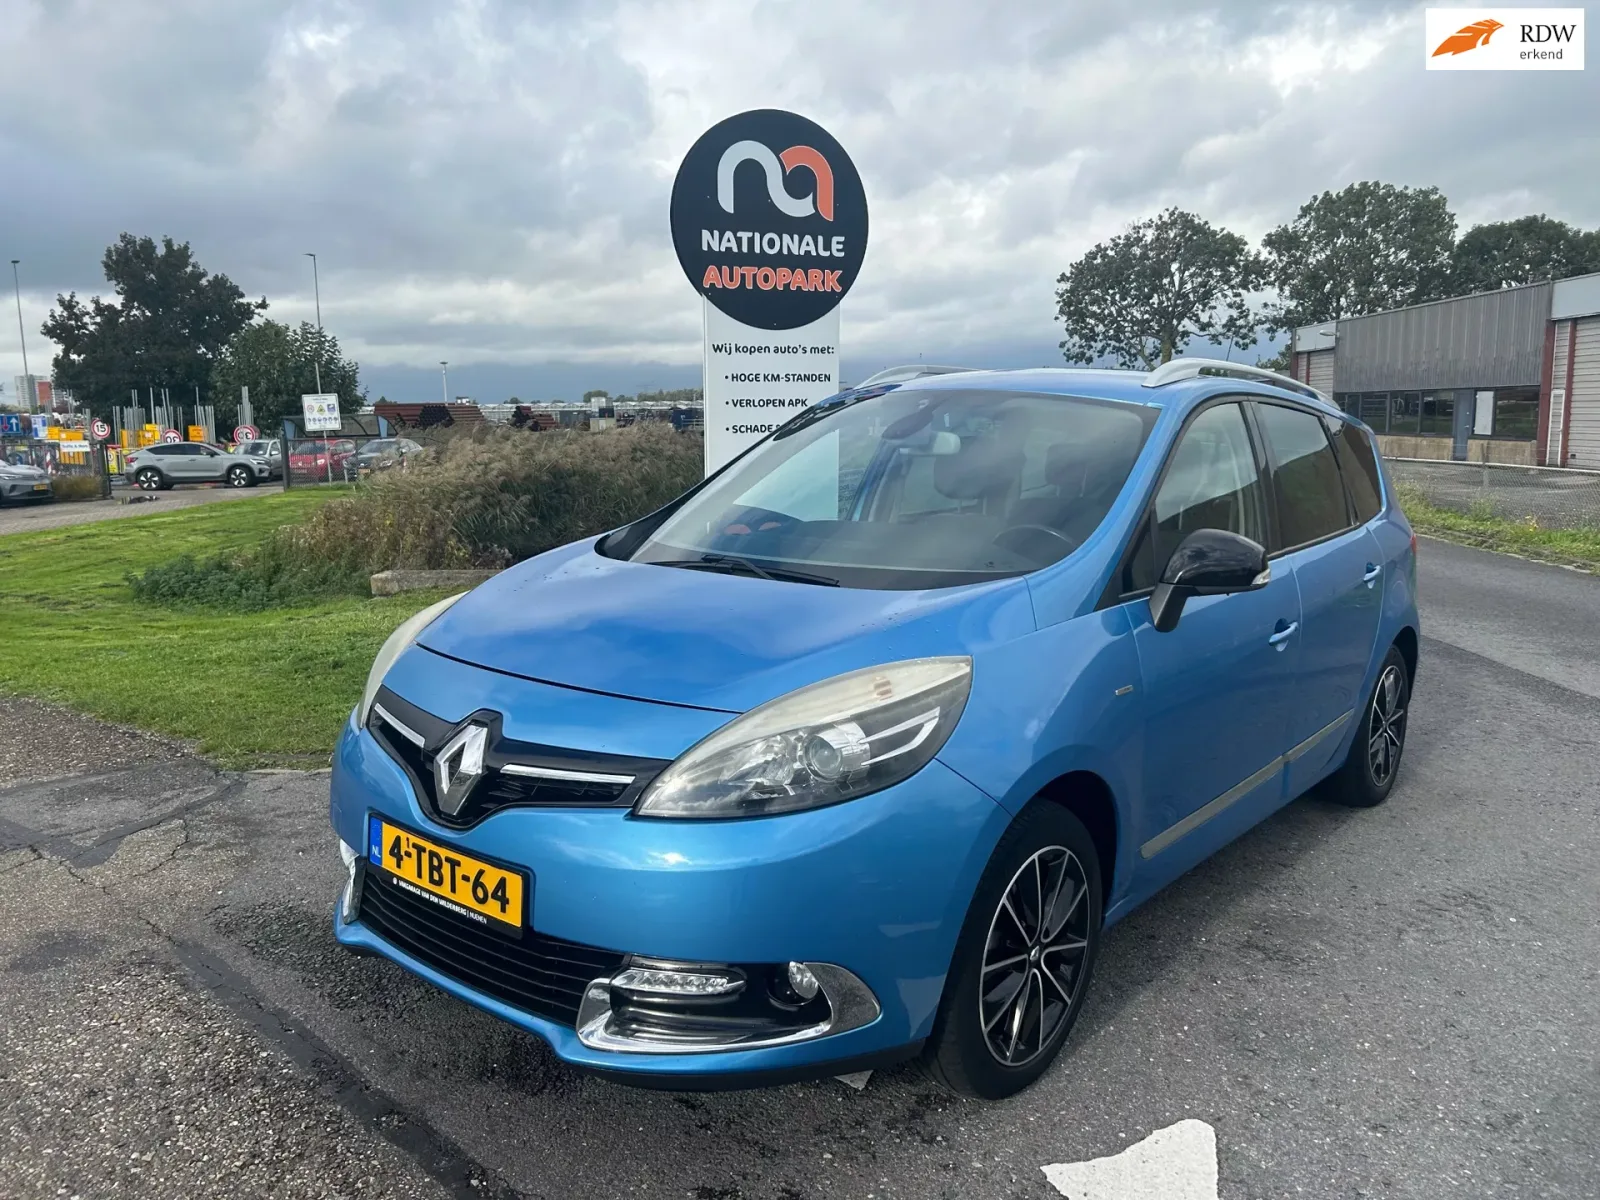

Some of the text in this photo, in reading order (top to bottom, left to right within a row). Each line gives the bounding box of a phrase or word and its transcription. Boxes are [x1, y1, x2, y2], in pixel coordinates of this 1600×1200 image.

[701, 229, 845, 257] NATIONALE
[703, 265, 843, 292] AUTOPARK
[712, 343, 834, 355] Wij kopen auto's met:
[731, 373, 831, 382] HOGE KM-STANDEN
[732, 398, 808, 407] VERLOPEN APK
[96, 424, 107, 433] 15
[732, 424, 773, 433] SCHADE
[371, 844, 381, 858] NL
[389, 835, 510, 914] 4-TBT-64
[421, 890, 429, 900] VAN
[429, 894, 438, 904] DEN
